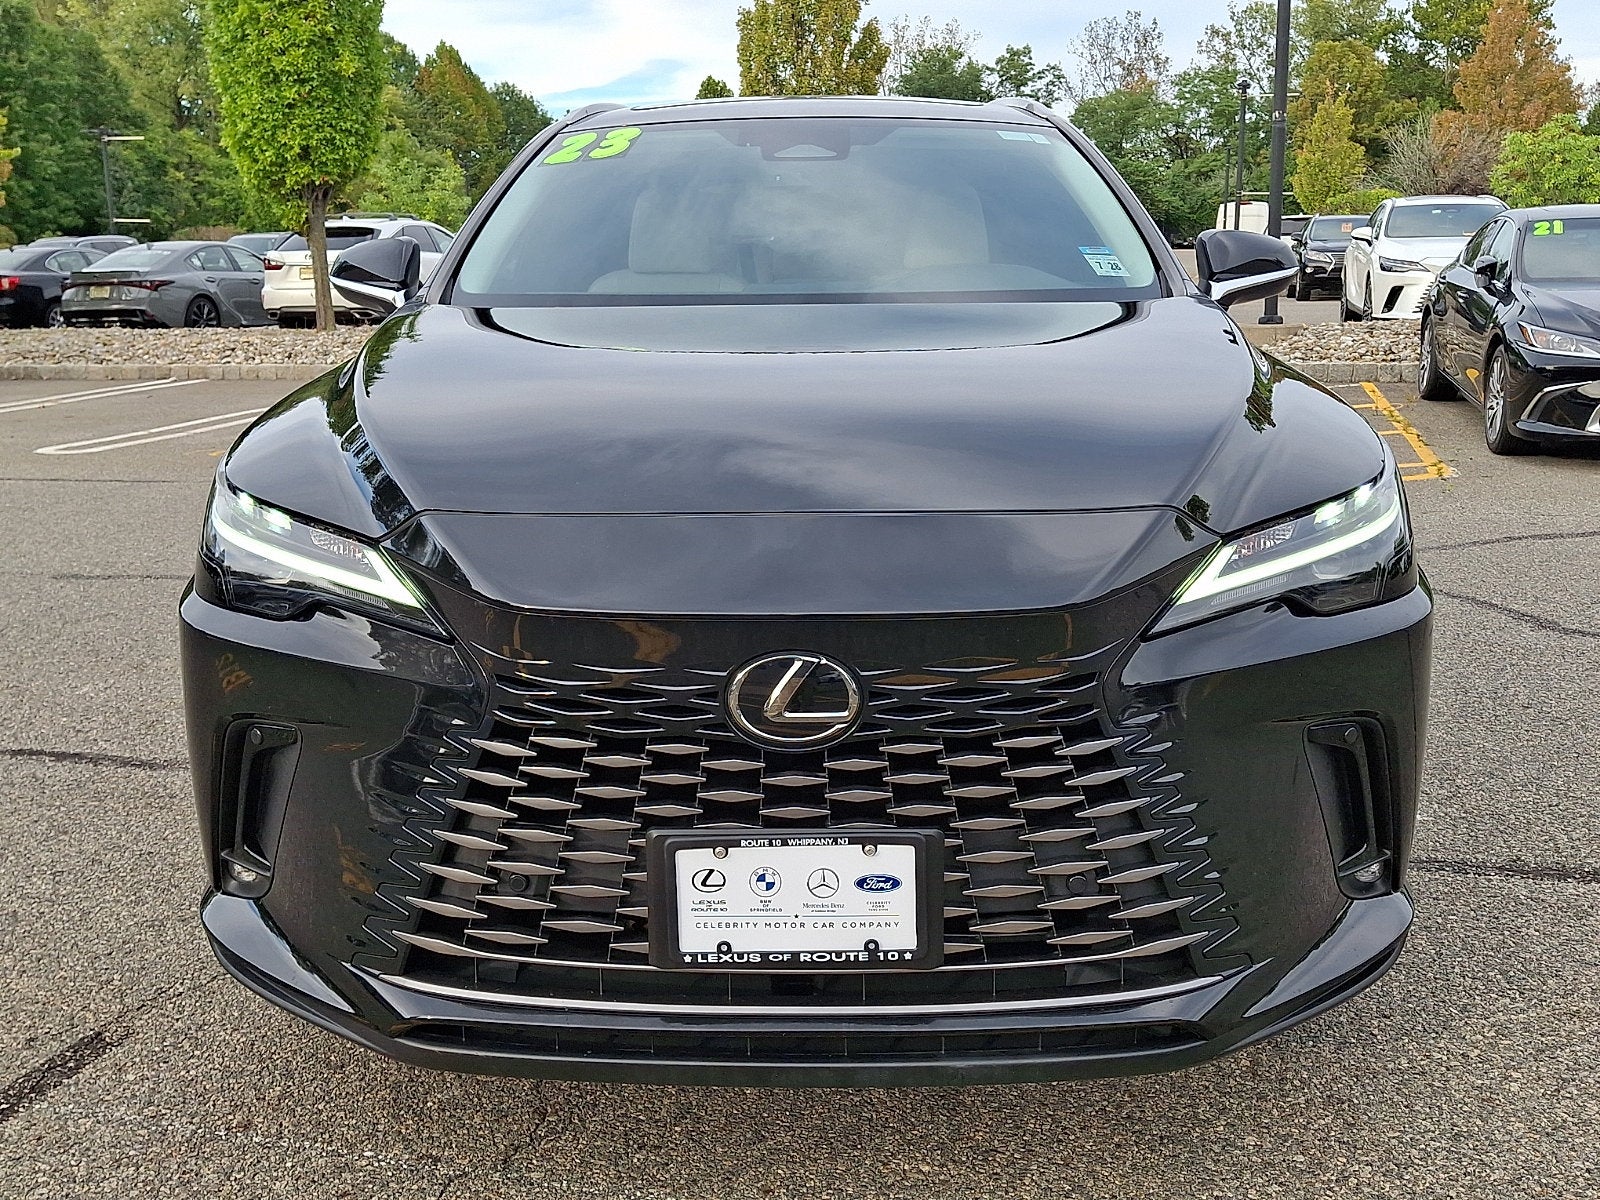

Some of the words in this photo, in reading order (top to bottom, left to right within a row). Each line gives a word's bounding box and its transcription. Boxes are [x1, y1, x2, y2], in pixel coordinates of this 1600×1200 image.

[543, 127, 642, 164] 23
[1533, 219, 1564, 236] 21
[1095, 261, 1103, 270] 7
[740, 839, 770, 848] ROUTE
[771, 839, 782, 847] 10
[787, 837, 836, 846] WHIPPANY,
[837, 837, 849, 846] NJ
[863, 877, 893, 889] Ford
[695, 921, 759, 929] CELEBRITY
[764, 921, 806, 929] MOTOR
[812, 921, 835, 929] CAR
[841, 921, 900, 929] COMPANY
[697, 953, 762, 963] LEXUS
[768, 953, 792, 962] OF
[799, 951, 869, 962] ROUTE
[876, 951, 899, 961] 10
